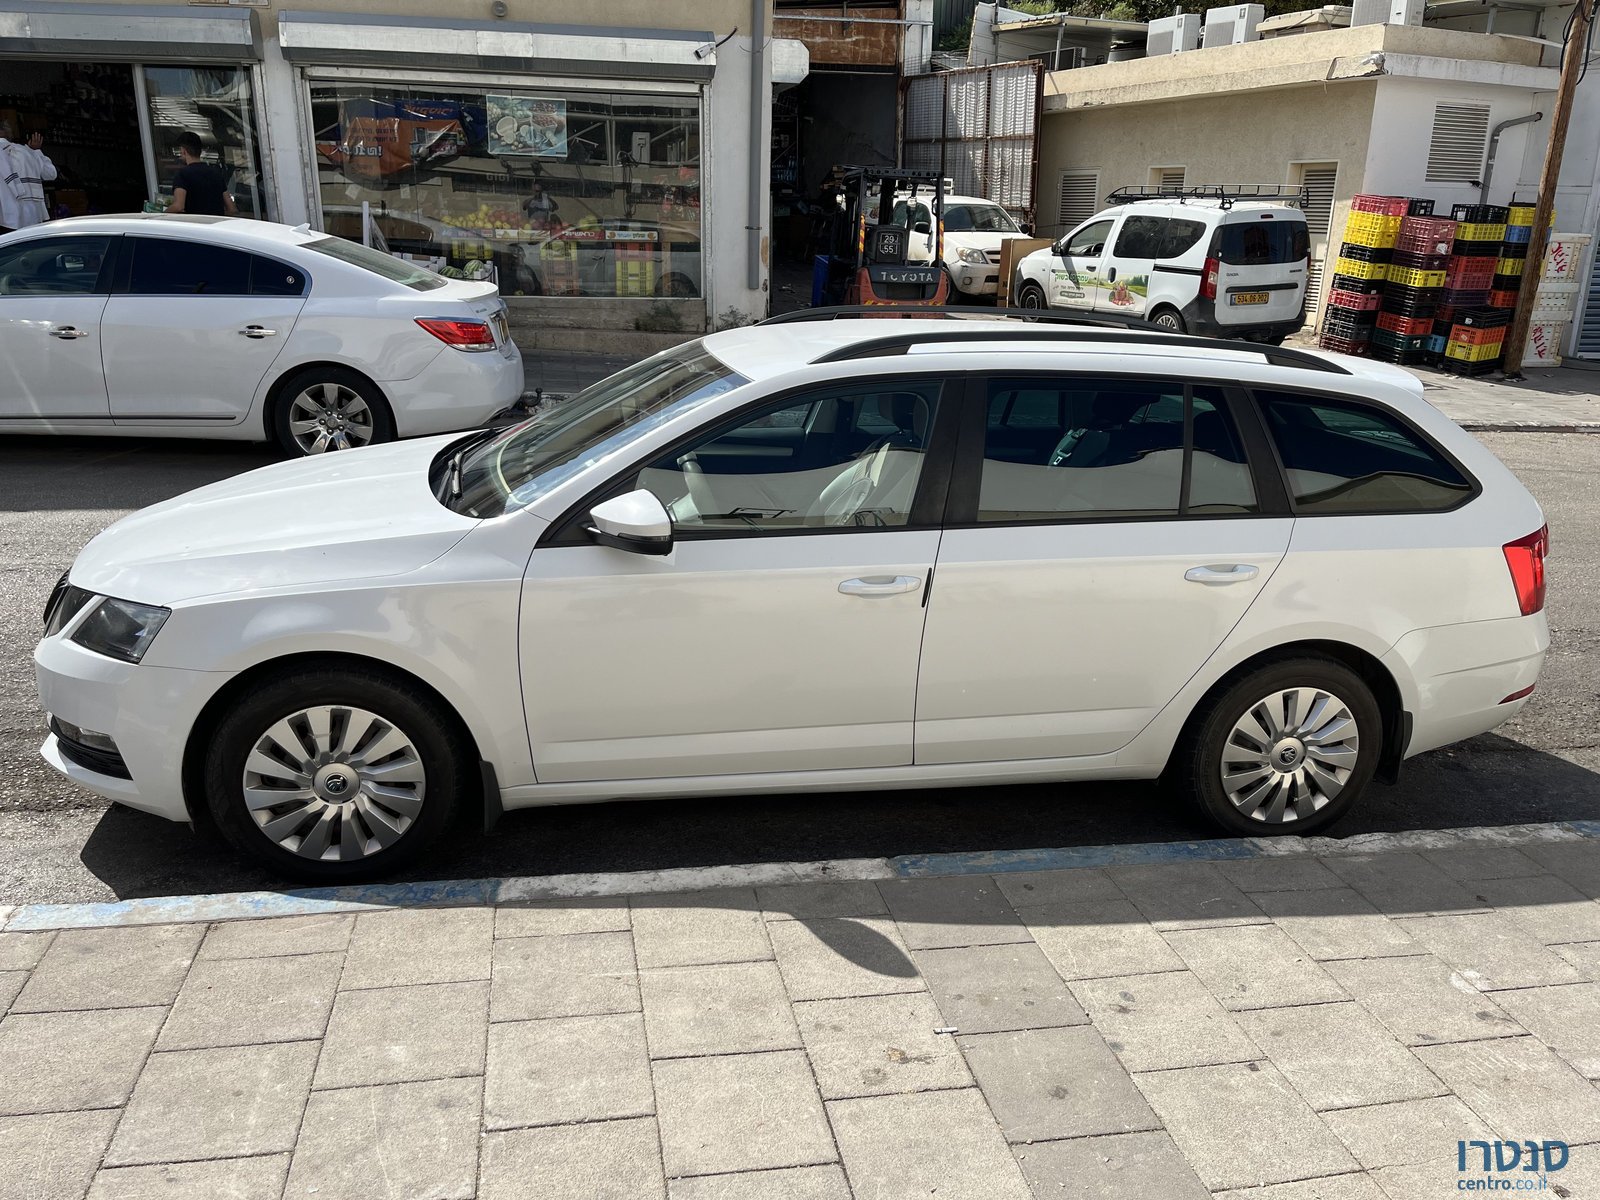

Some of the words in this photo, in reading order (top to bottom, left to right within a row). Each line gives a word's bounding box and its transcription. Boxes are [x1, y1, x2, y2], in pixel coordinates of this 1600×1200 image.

[884, 235, 895, 244] 29
[883, 245, 894, 254] 55
[881, 271, 933, 282] TOYOTA
